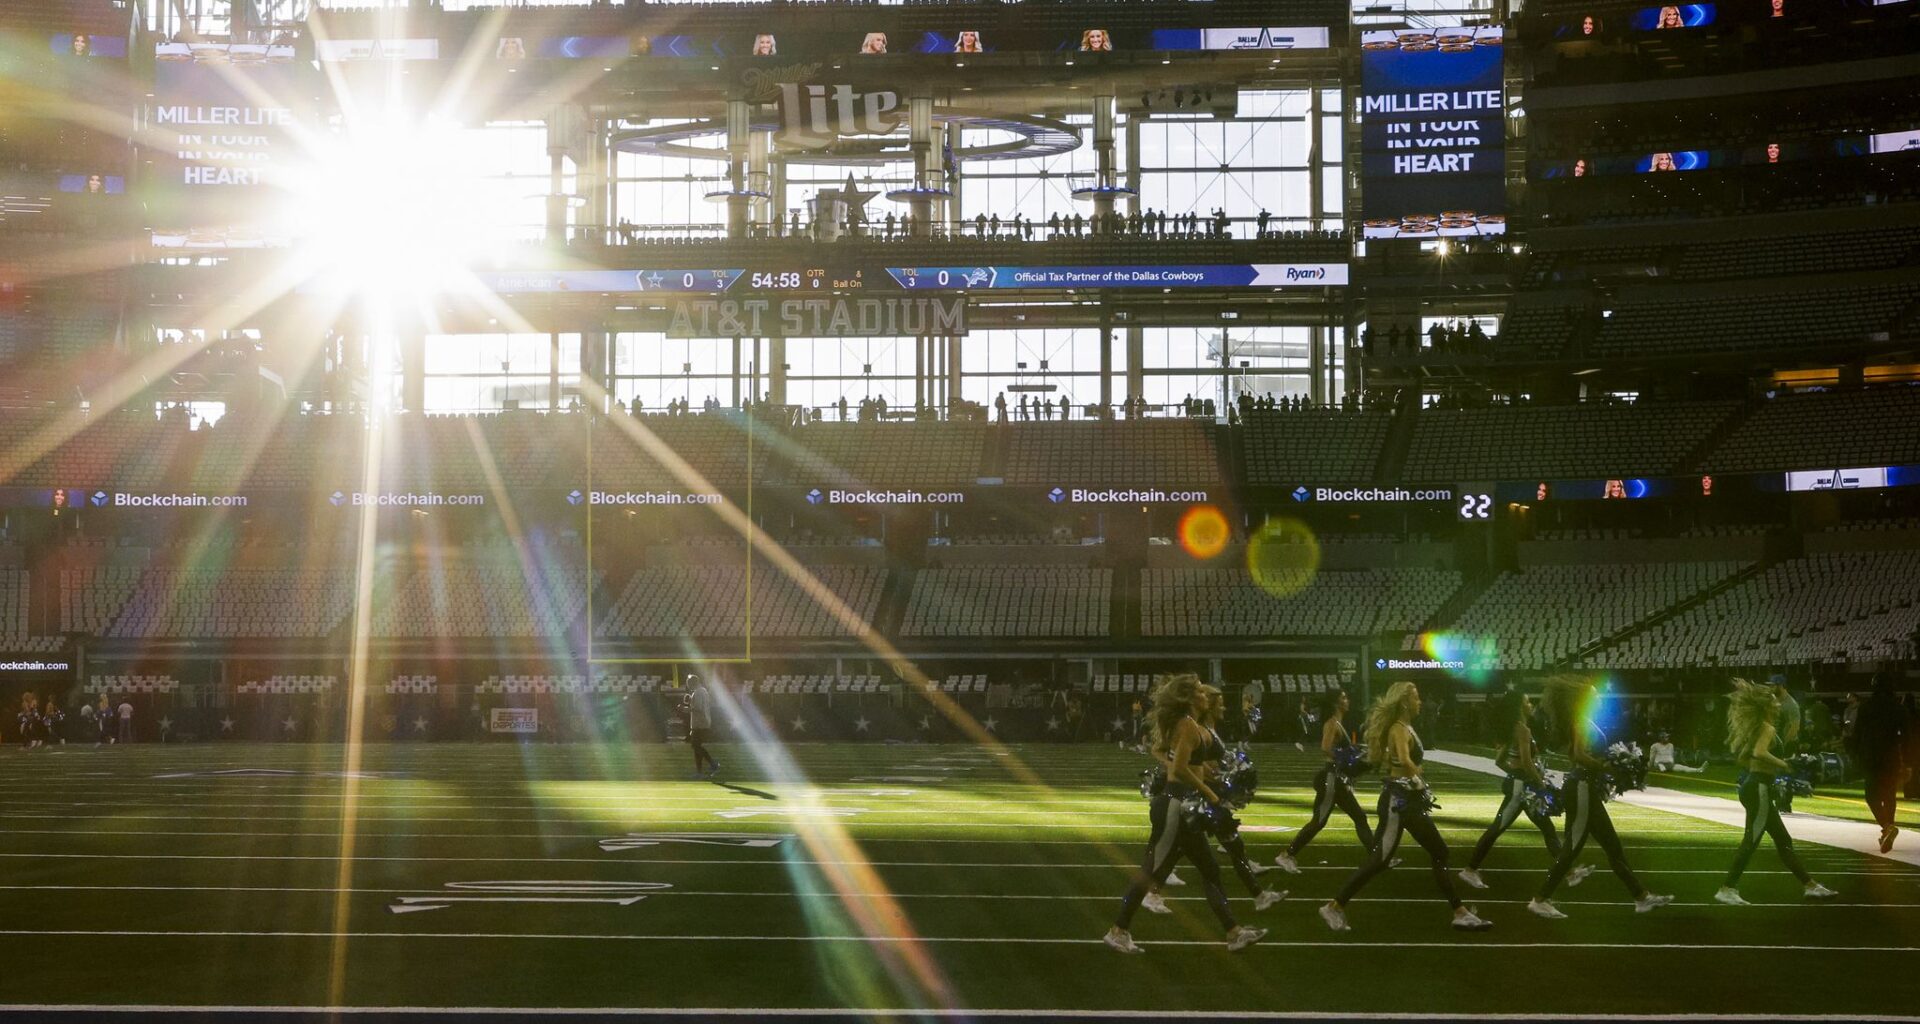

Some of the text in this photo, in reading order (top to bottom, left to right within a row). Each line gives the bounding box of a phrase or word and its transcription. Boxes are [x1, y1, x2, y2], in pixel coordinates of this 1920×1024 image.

[1365, 90, 1501, 113] MILLER LITE
[157, 106, 292, 125] MILLER LITE
[775, 83, 897, 149] Lite
[1394, 152, 1474, 174] HEART
[184, 166, 264, 185] HEART
[712, 270, 729, 278] TOL
[807, 269, 825, 277] QTR
[902, 268, 919, 276] TOL
[938, 271, 949, 286] 0
[1014, 271, 1205, 282] Official Tax Partner of the Dallas Cowboys
[1286, 267, 1316, 281] Ryan
[683, 273, 694, 288] 0
[717, 280, 724, 289] 3
[751, 272, 801, 288] 54:58
[813, 279, 820, 288] 0
[833, 280, 862, 288] Ball On
[908, 277, 916, 287] 3
[669, 299, 967, 337] AT&T STADIUM
[114, 492, 248, 507] Blockchain.com
[351, 491, 484, 506] Blockchain.com
[589, 491, 723, 505] Blockchain.com
[829, 490, 964, 504] Blockchain.com
[1071, 488, 1208, 502] Blockchain.com
[1315, 487, 1452, 501] Blockchain.com
[1461, 494, 1491, 519] 22
[1388, 659, 1464, 669] Blockchain.com
